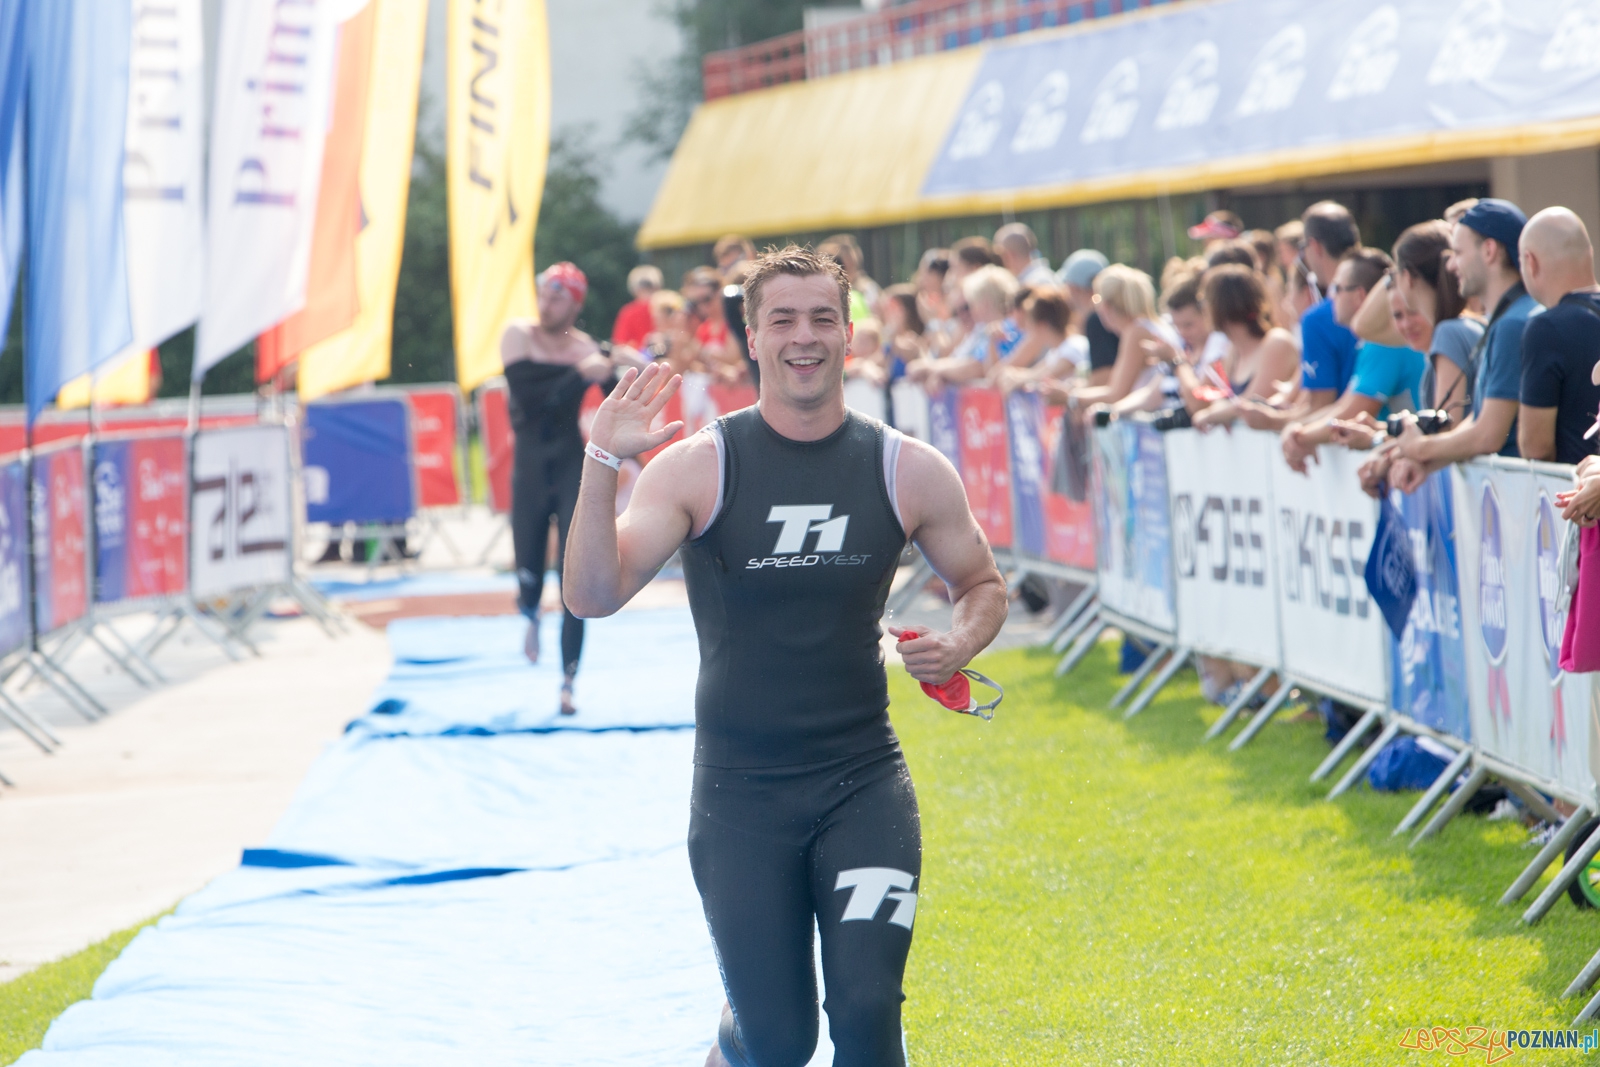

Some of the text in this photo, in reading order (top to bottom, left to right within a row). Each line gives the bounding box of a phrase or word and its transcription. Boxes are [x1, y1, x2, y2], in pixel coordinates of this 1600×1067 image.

[469, 0, 500, 191] FINI
[765, 503, 851, 555] T1
[744, 554, 872, 569] SPEEDVEST
[833, 866, 918, 932] T1
